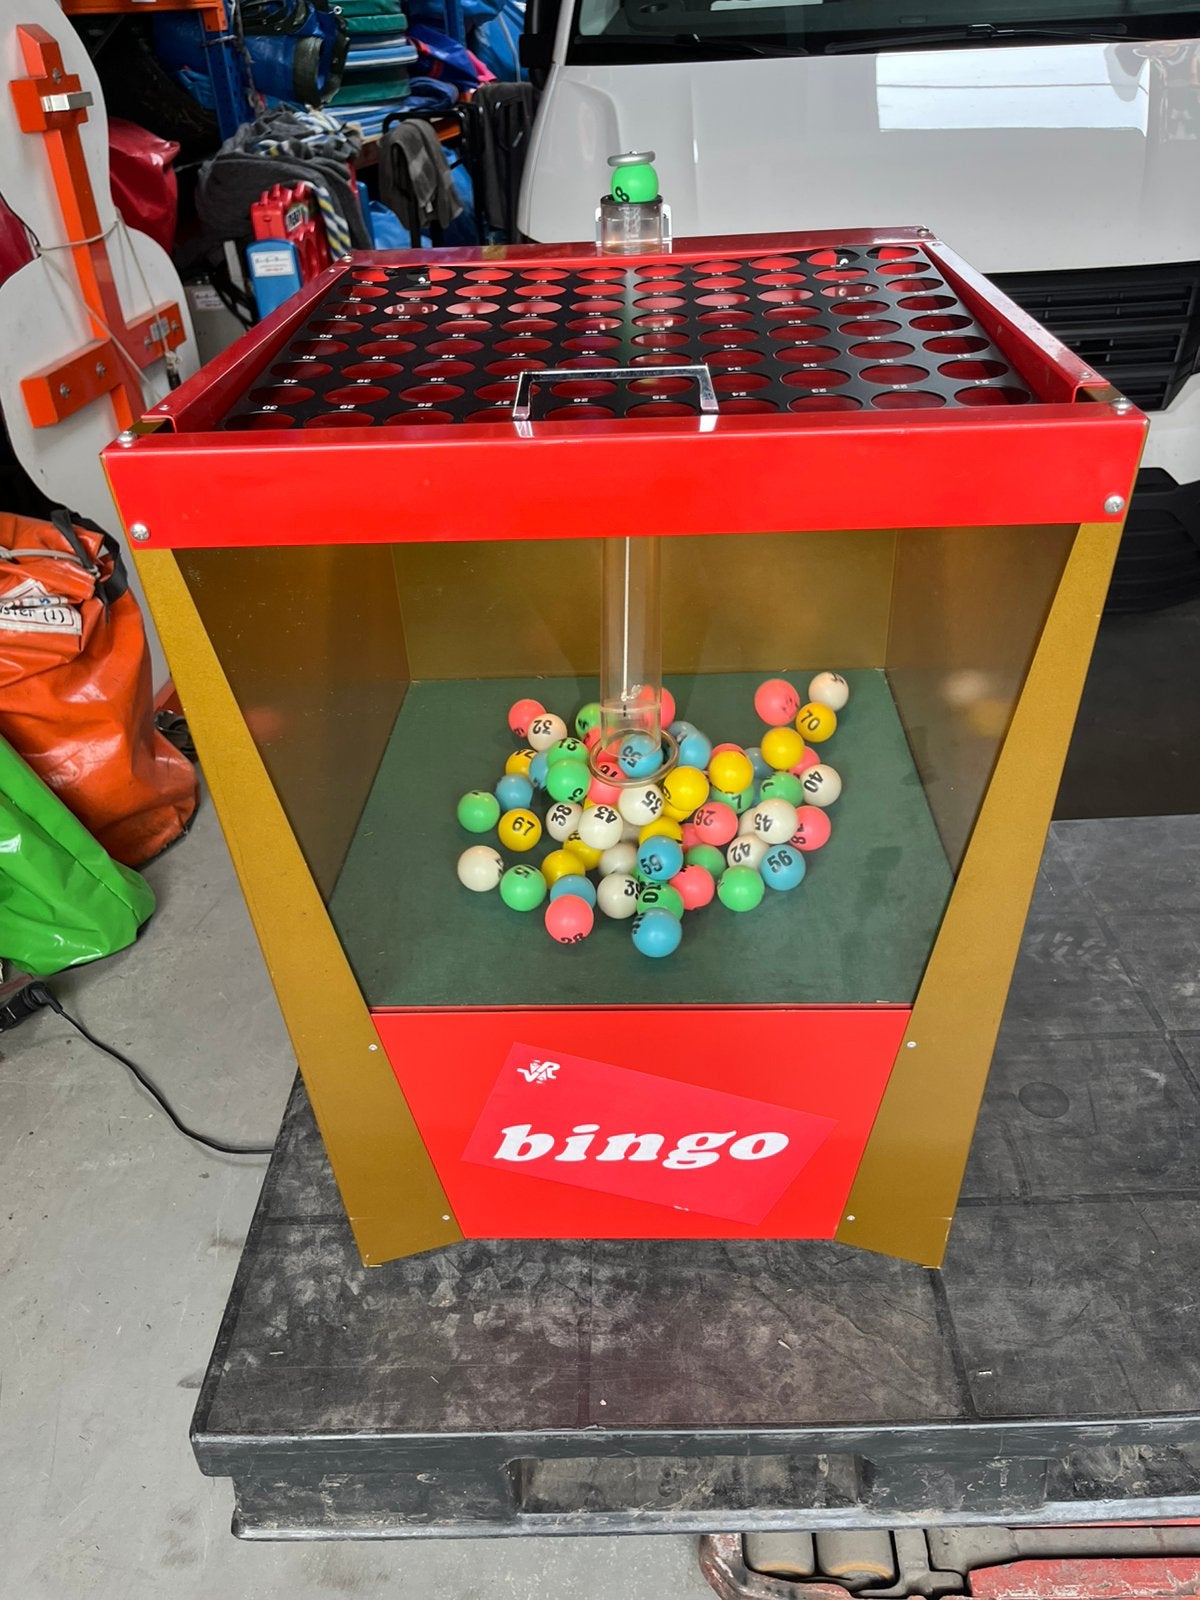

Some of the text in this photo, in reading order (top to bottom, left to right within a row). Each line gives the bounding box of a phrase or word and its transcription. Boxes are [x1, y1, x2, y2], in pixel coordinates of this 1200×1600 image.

[44, 608, 65, 623] (1)
[532, 719, 552, 734] 32
[800, 710, 820, 731] 70
[558, 738, 580, 752] 13
[804, 771, 823, 792] 40
[641, 790, 662, 815] 35
[550, 804, 572, 826] 38
[593, 806, 618, 824] 43
[696, 810, 716, 826] 26
[754, 813, 773, 832] 45
[512, 816, 536, 836] 67
[730, 842, 751, 863] 42
[766, 850, 793, 873] 56
[640, 854, 662, 875] 59
[493, 1123, 790, 1171] bingo
